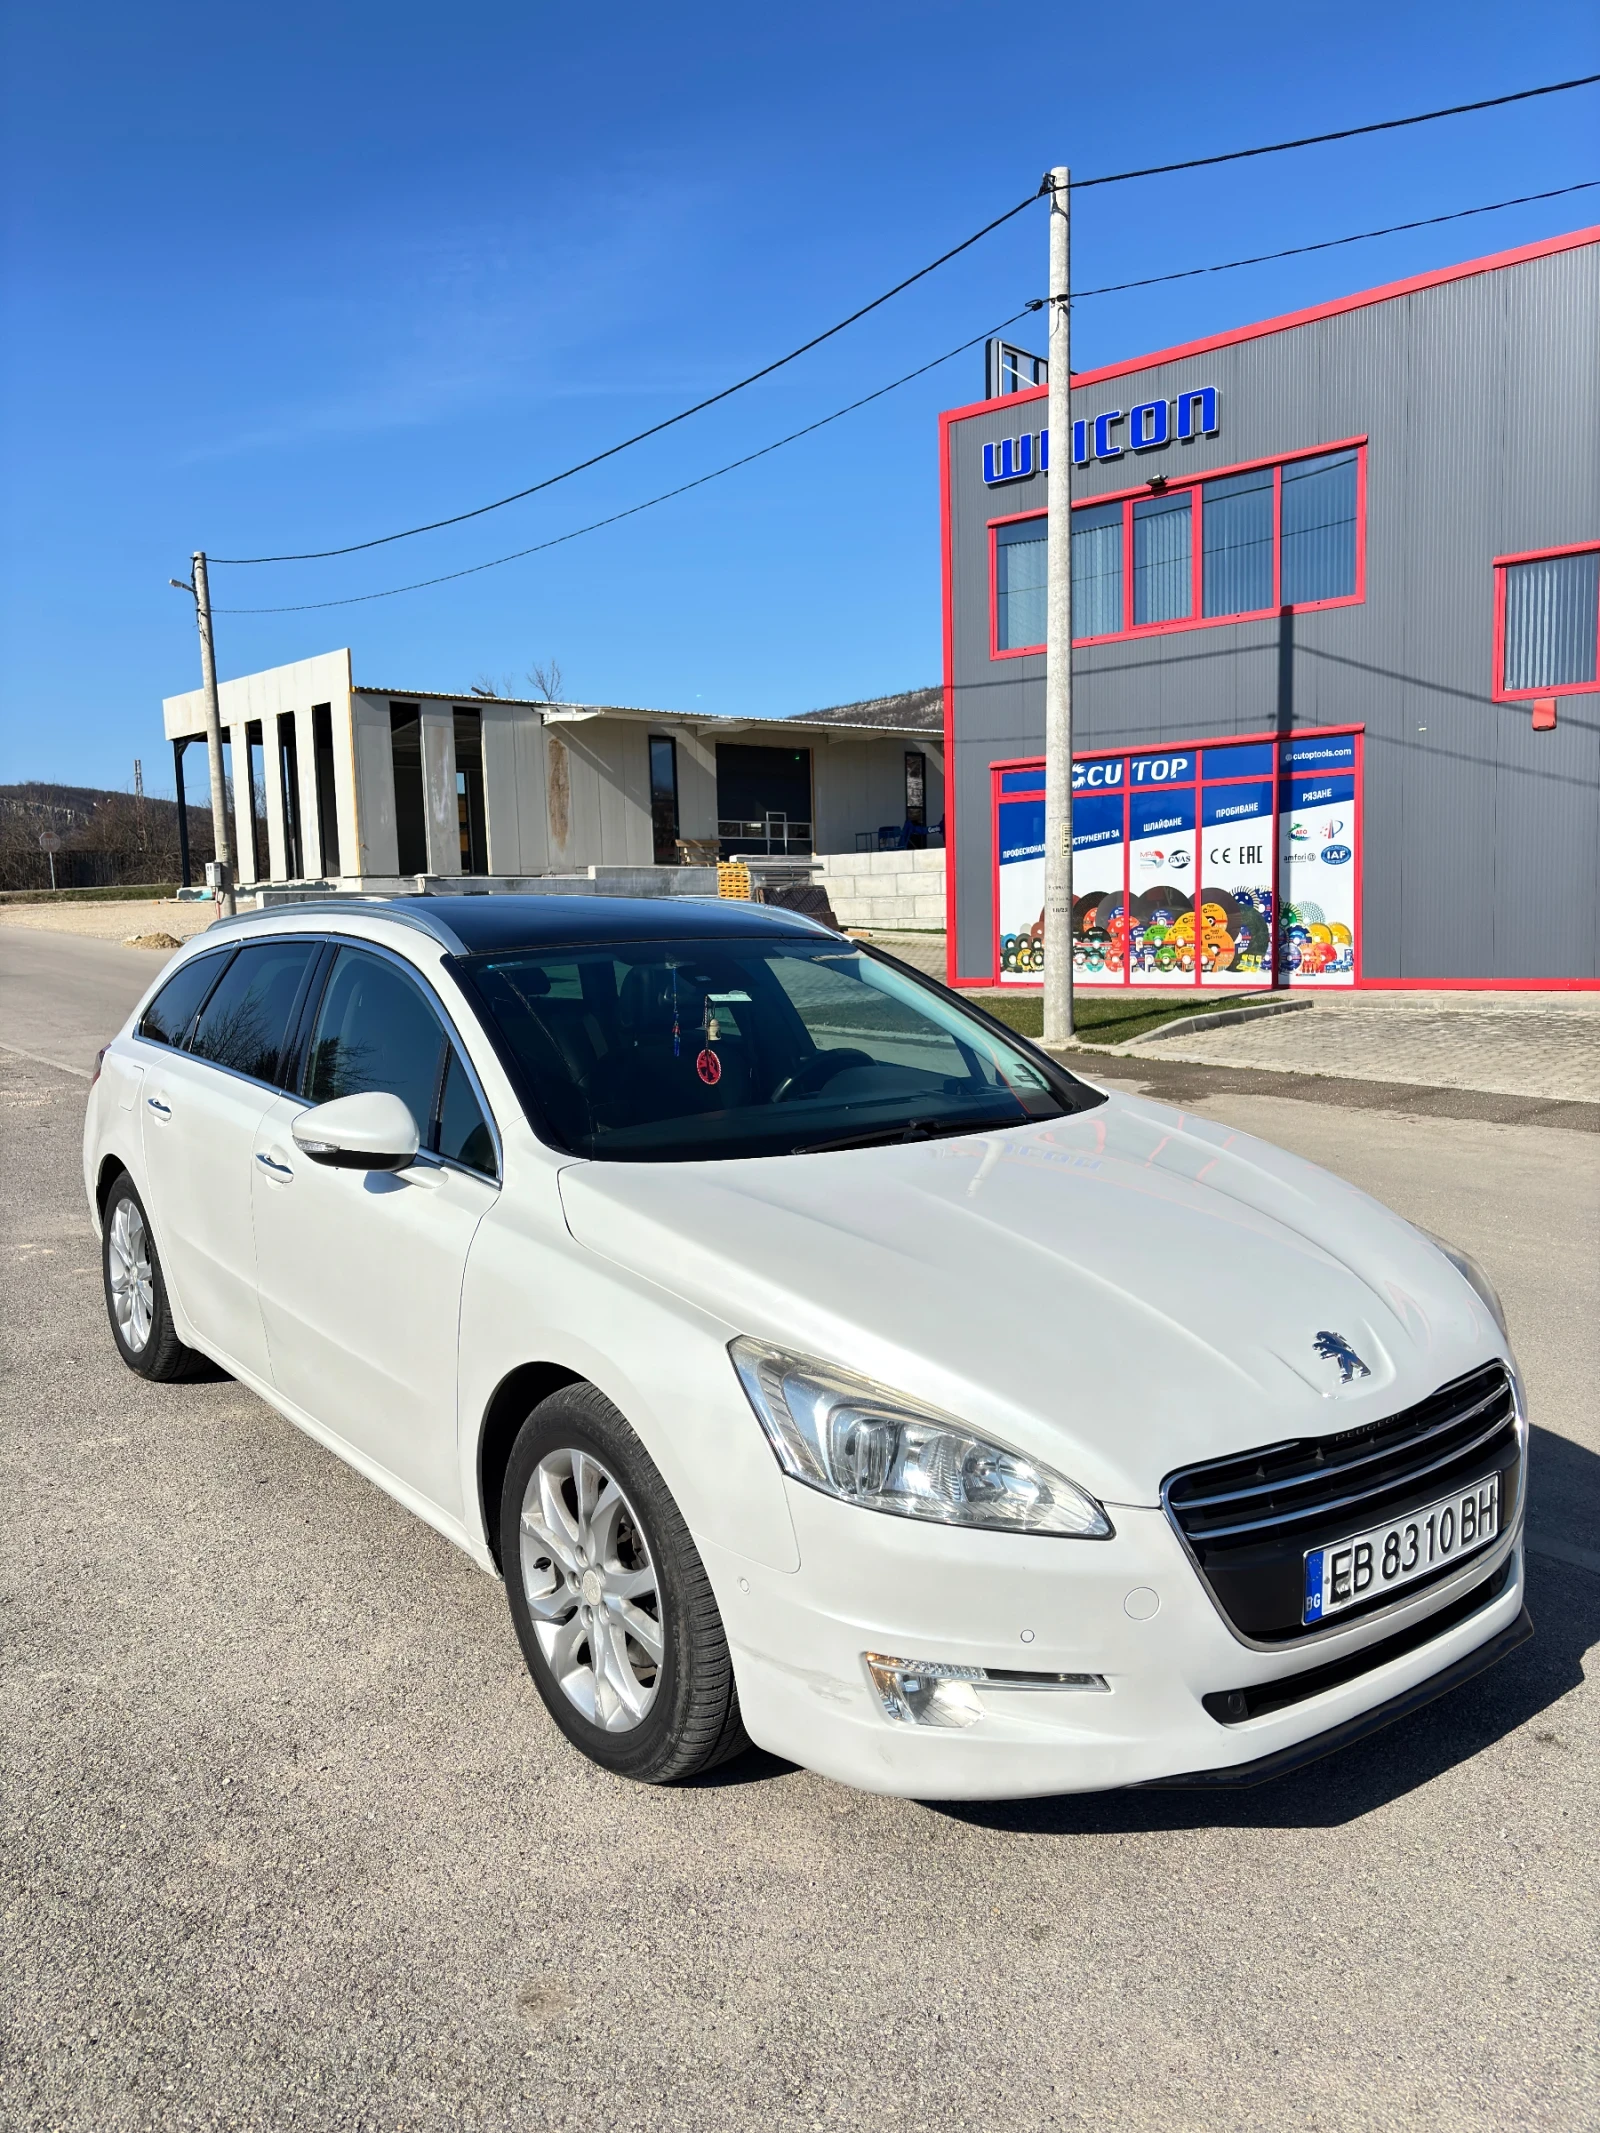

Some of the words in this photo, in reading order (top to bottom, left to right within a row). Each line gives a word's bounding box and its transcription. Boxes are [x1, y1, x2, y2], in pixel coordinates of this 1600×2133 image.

[1293, 748, 1352, 761] cutoptools.com
[1302, 788, 1332, 802] РЯЗАНЕ
[1215, 802, 1259, 818] ПРОБИВАНЕ
[1143, 817, 1182, 832] ШЛАЙФАНЕ
[1002, 843, 1045, 859] ПРОФЕСИОНАЛ
[1111, 829, 1120, 838] ЗА
[1326, 850, 1346, 859] IAF
[1335, 1413, 1400, 1441] PEUGEOT
[1329, 1541, 1373, 1605] EB
[1381, 1506, 1454, 1580] 8310
[1459, 1484, 1495, 1548] BH
[1306, 1593, 1321, 1612] BG
